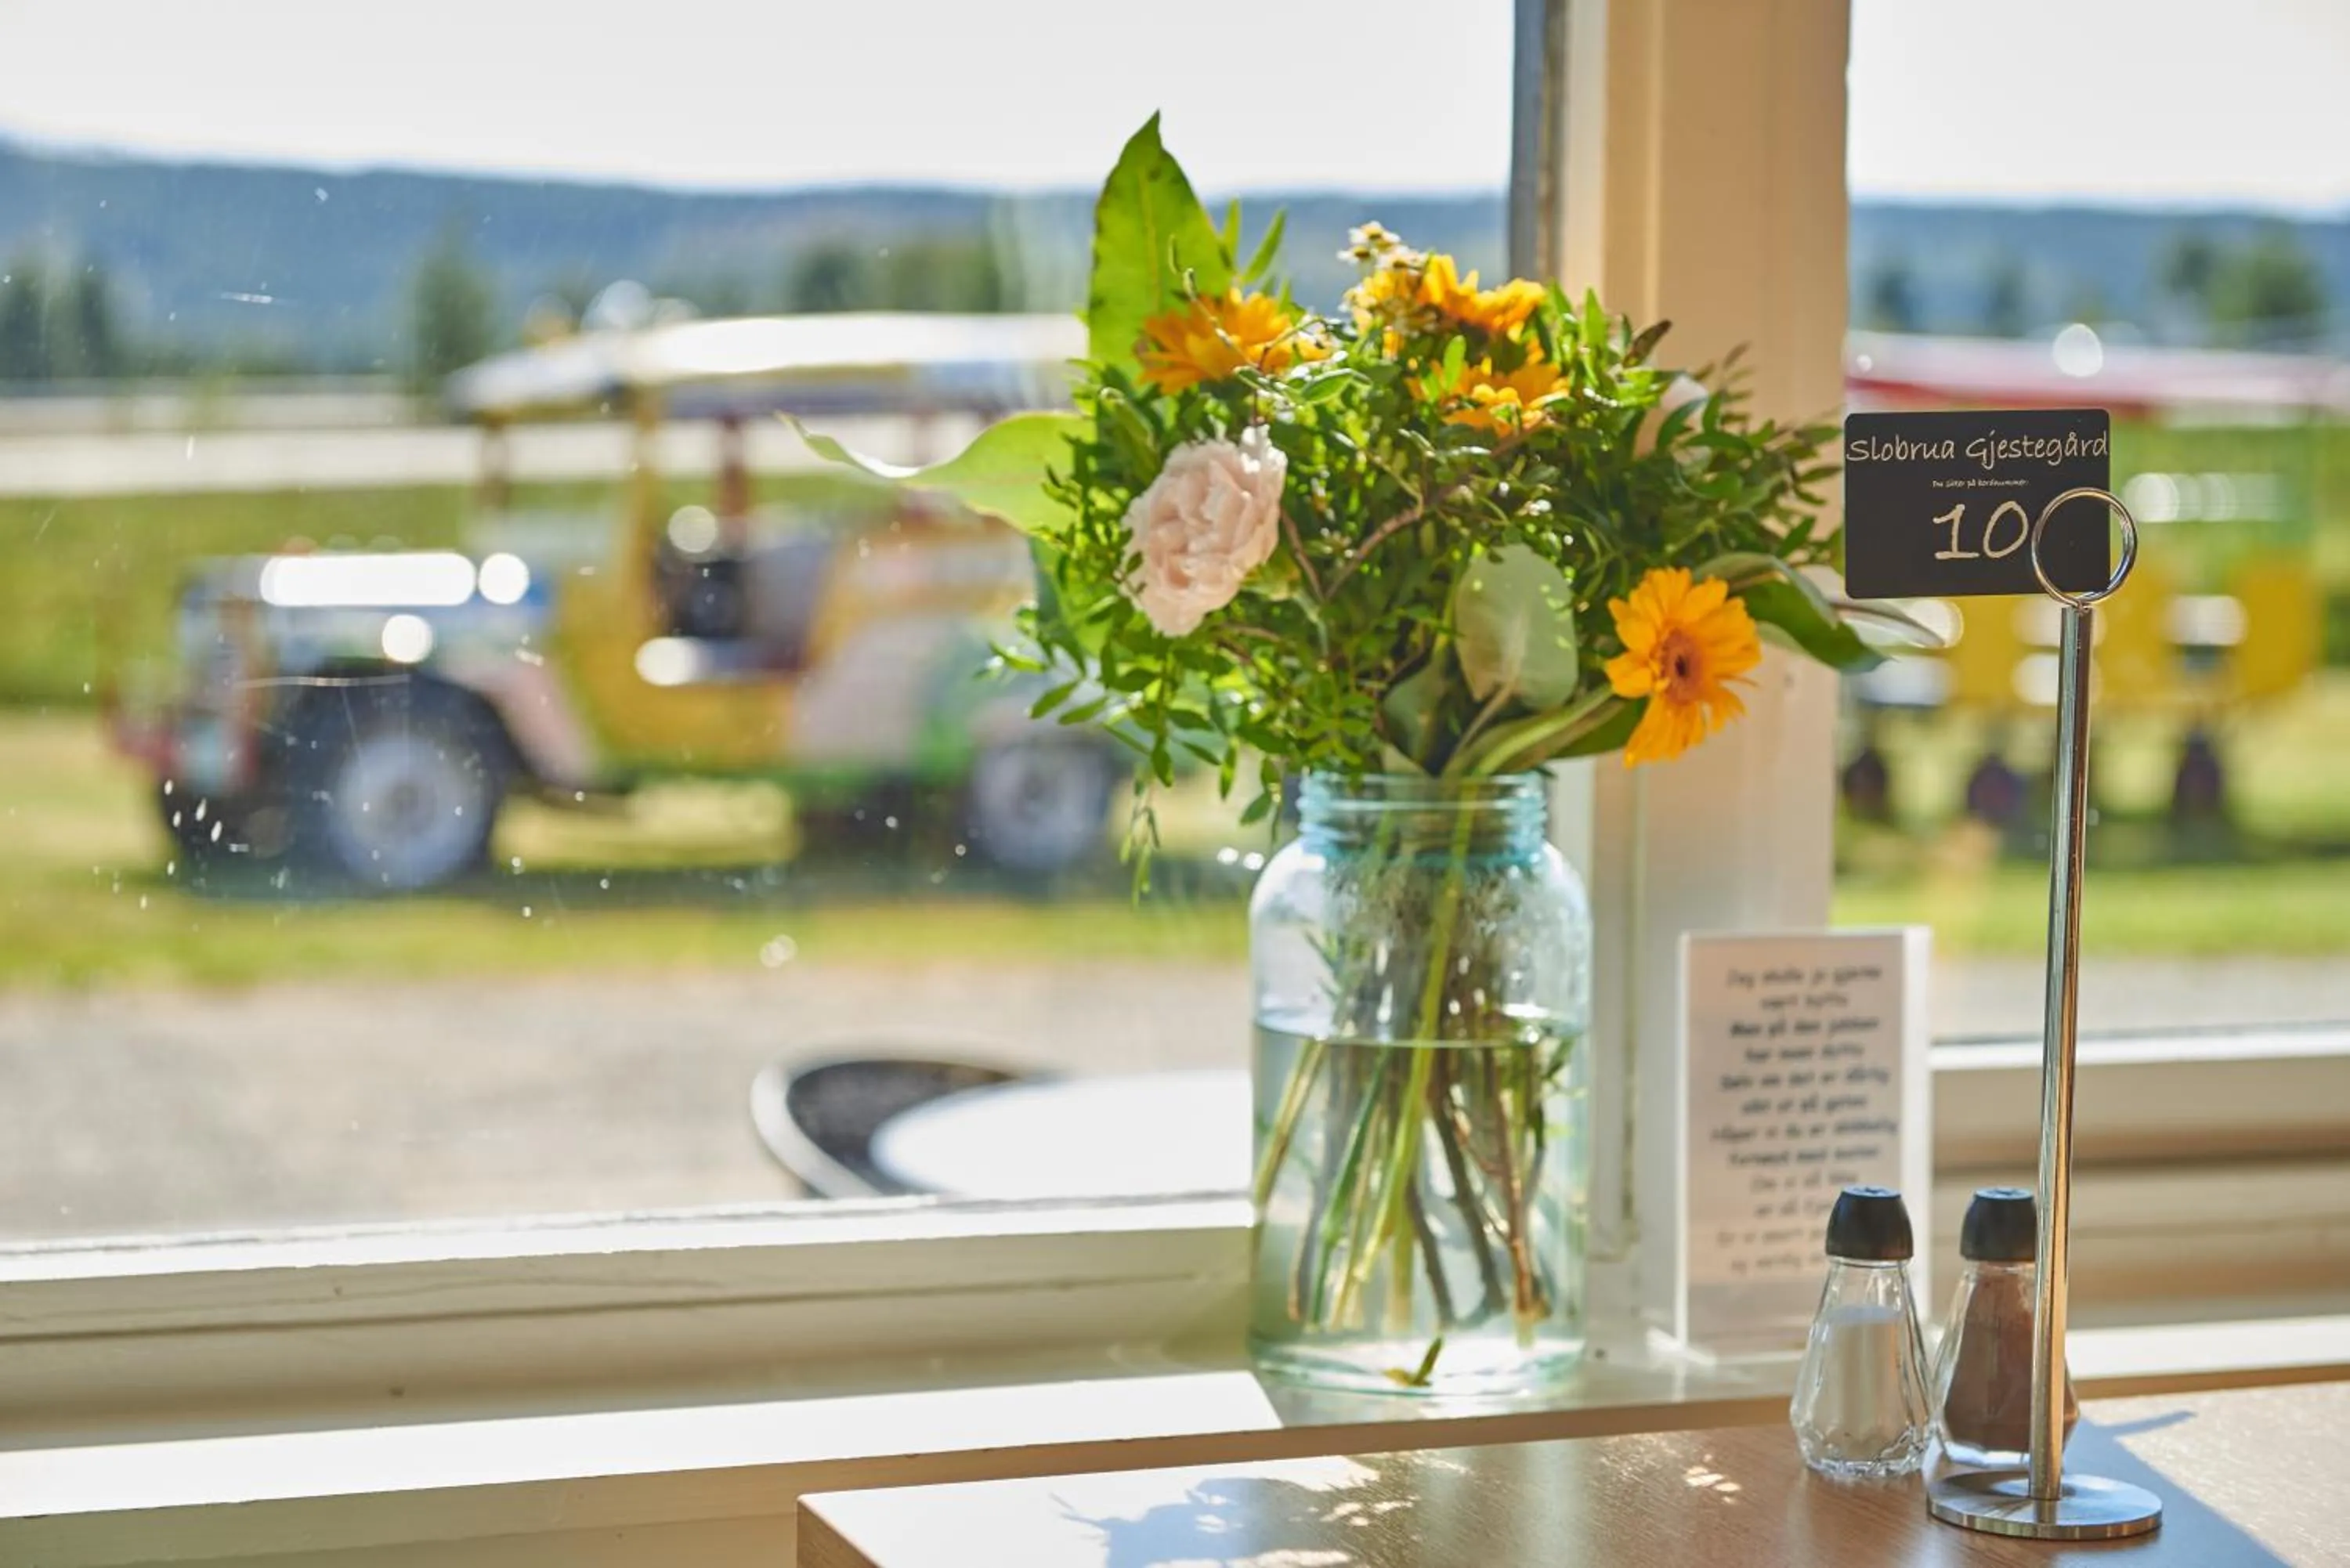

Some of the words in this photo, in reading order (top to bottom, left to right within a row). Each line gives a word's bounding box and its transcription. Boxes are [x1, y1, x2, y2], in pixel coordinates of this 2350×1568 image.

[1846, 434, 1955, 462] Slobrua
[1965, 428, 2109, 470] Gjestegård
[1932, 500, 2029, 560] 10
